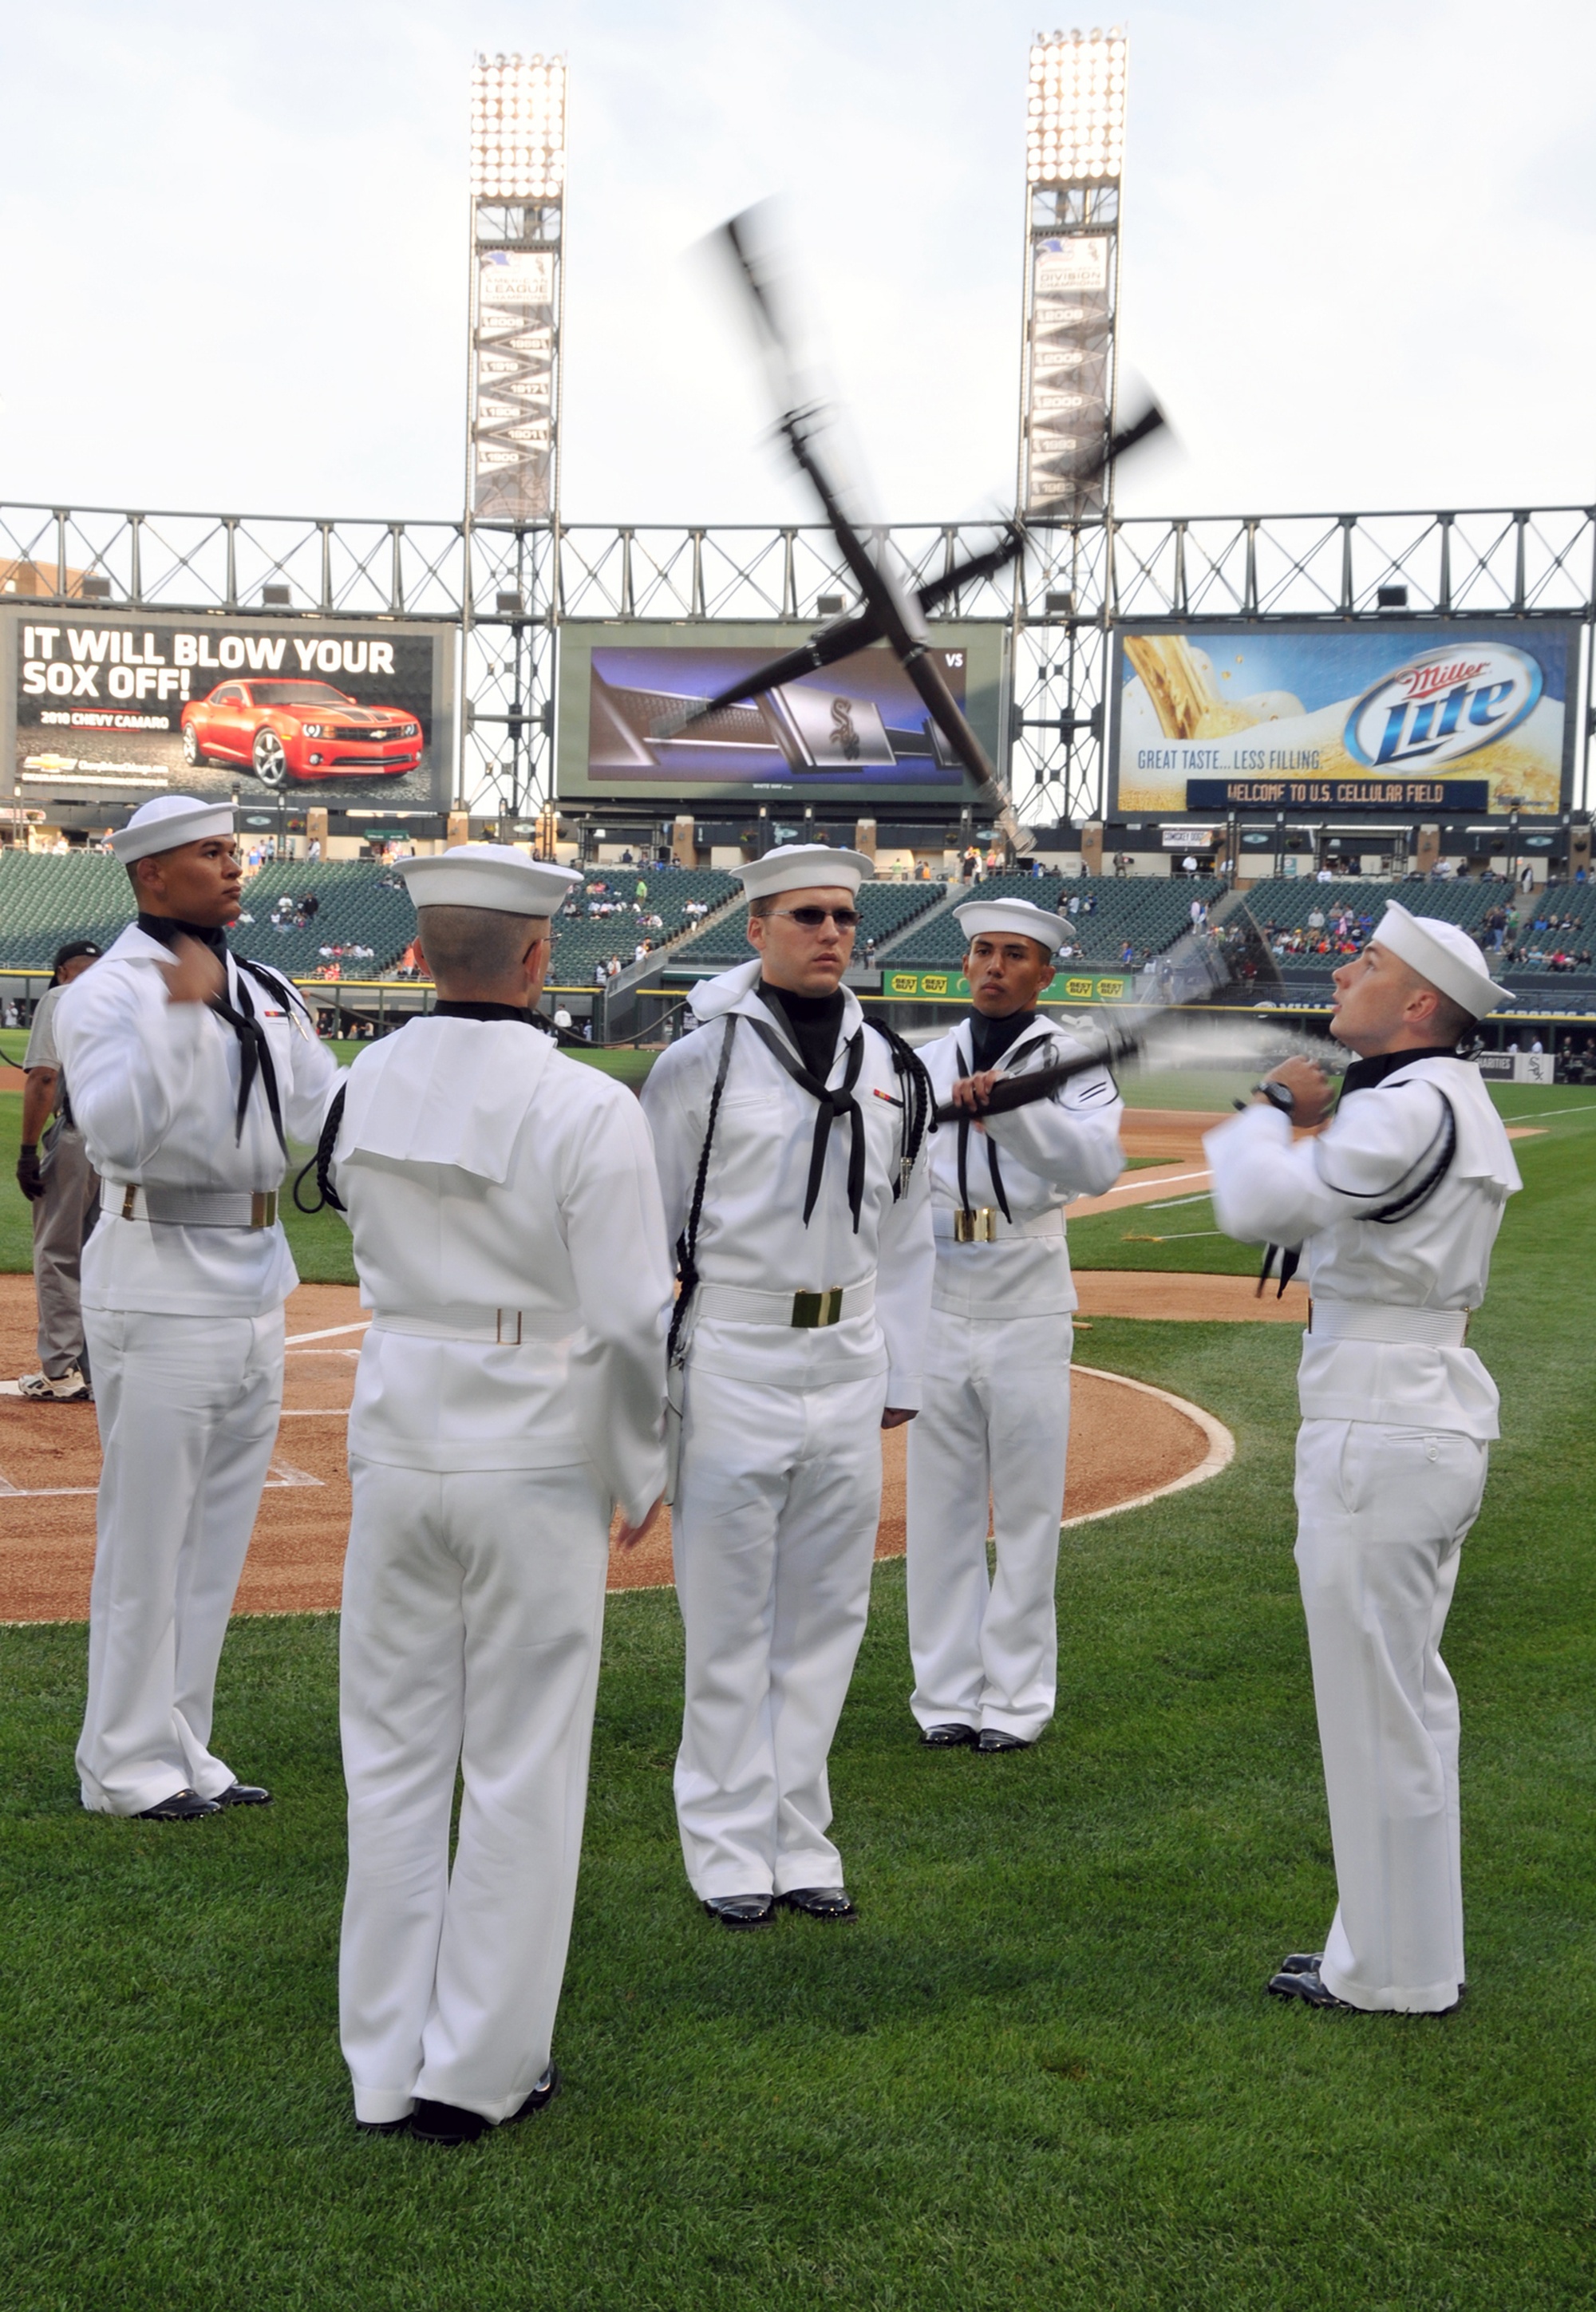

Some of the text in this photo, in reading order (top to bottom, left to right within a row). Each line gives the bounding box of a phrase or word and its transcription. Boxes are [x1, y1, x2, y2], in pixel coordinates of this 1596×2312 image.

[1041, 272, 1100, 282] DIVISION
[485, 284, 547, 293] LEAGUE
[510, 384, 540, 393] 1917
[508, 429, 538, 439] 1901
[24, 626, 395, 674] IT WILL BLOW YOUR
[946, 653, 963, 667] VS
[23, 661, 190, 701] SOX OFF!
[1396, 662, 1491, 695] Miller
[41, 711, 169, 729] 2010 CHEVY CAMARO
[1372, 679, 1515, 767] Lite
[1138, 750, 1177, 769] GREAT
[1183, 750, 1231, 769] TASTE...
[1235, 750, 1265, 769] LESS
[1227, 784, 1444, 803] WELCOME TO U.S. CELLULAR FIELD
